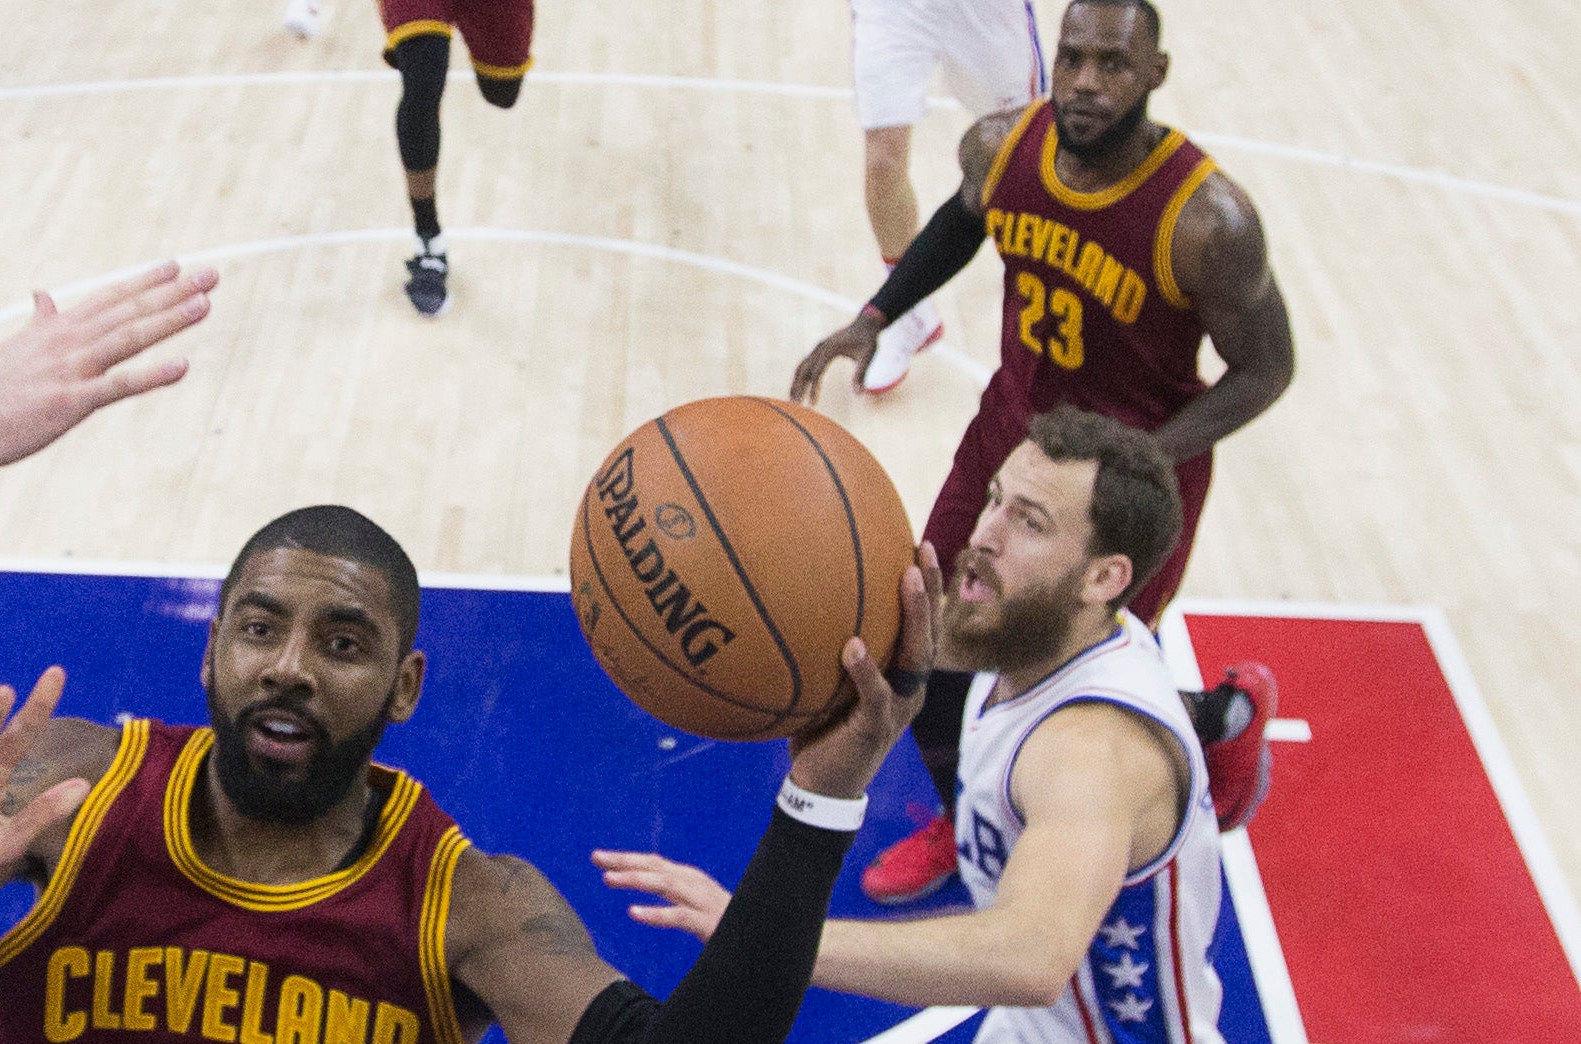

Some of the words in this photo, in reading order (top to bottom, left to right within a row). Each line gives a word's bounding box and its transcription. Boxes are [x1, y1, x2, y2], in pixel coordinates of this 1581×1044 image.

[986, 208, 1147, 324] CLEVELAND
[1016, 272, 1085, 370] 23
[596, 446, 736, 667] SPALDING
